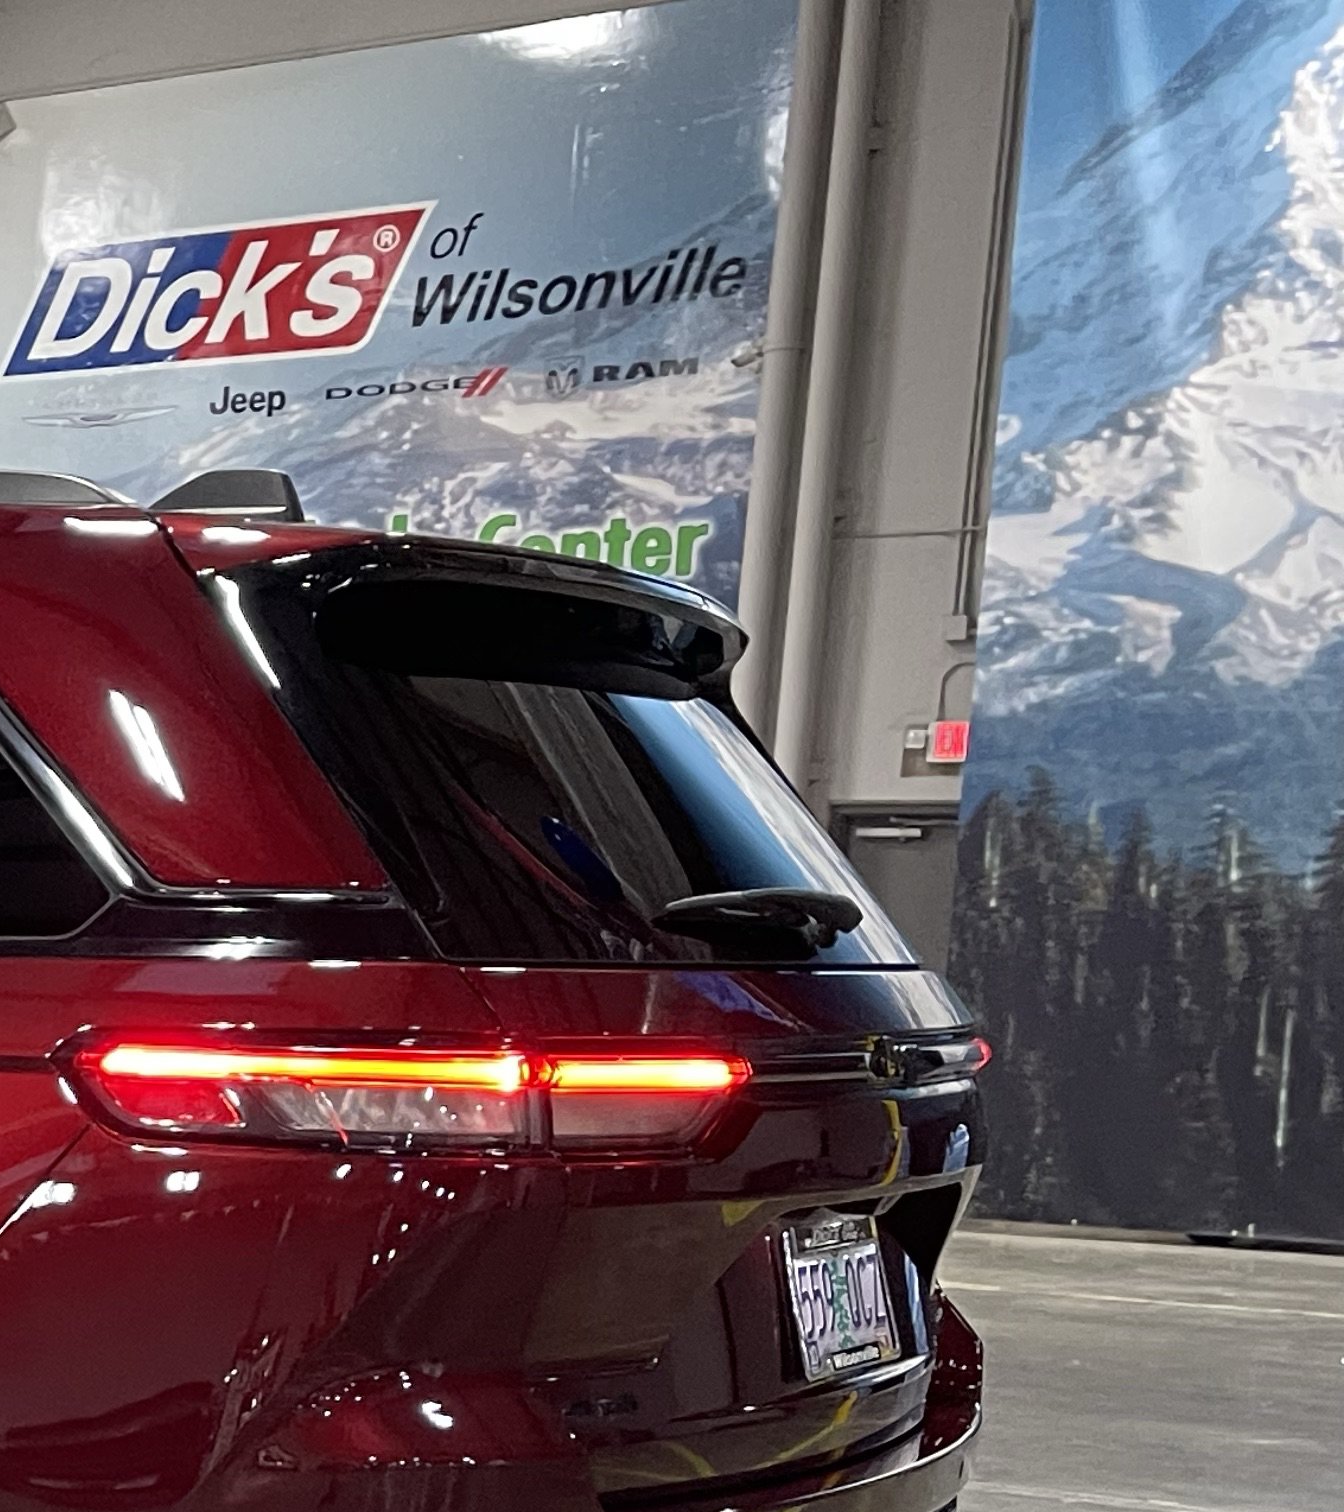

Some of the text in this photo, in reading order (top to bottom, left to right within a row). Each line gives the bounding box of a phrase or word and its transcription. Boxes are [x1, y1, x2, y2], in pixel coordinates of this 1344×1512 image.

[430, 213, 484, 259] of
[411, 245, 747, 328] Wilsonville
[210, 357, 700, 416] Jeep DODGE RAM
[797, 1260, 836, 1339] 559
